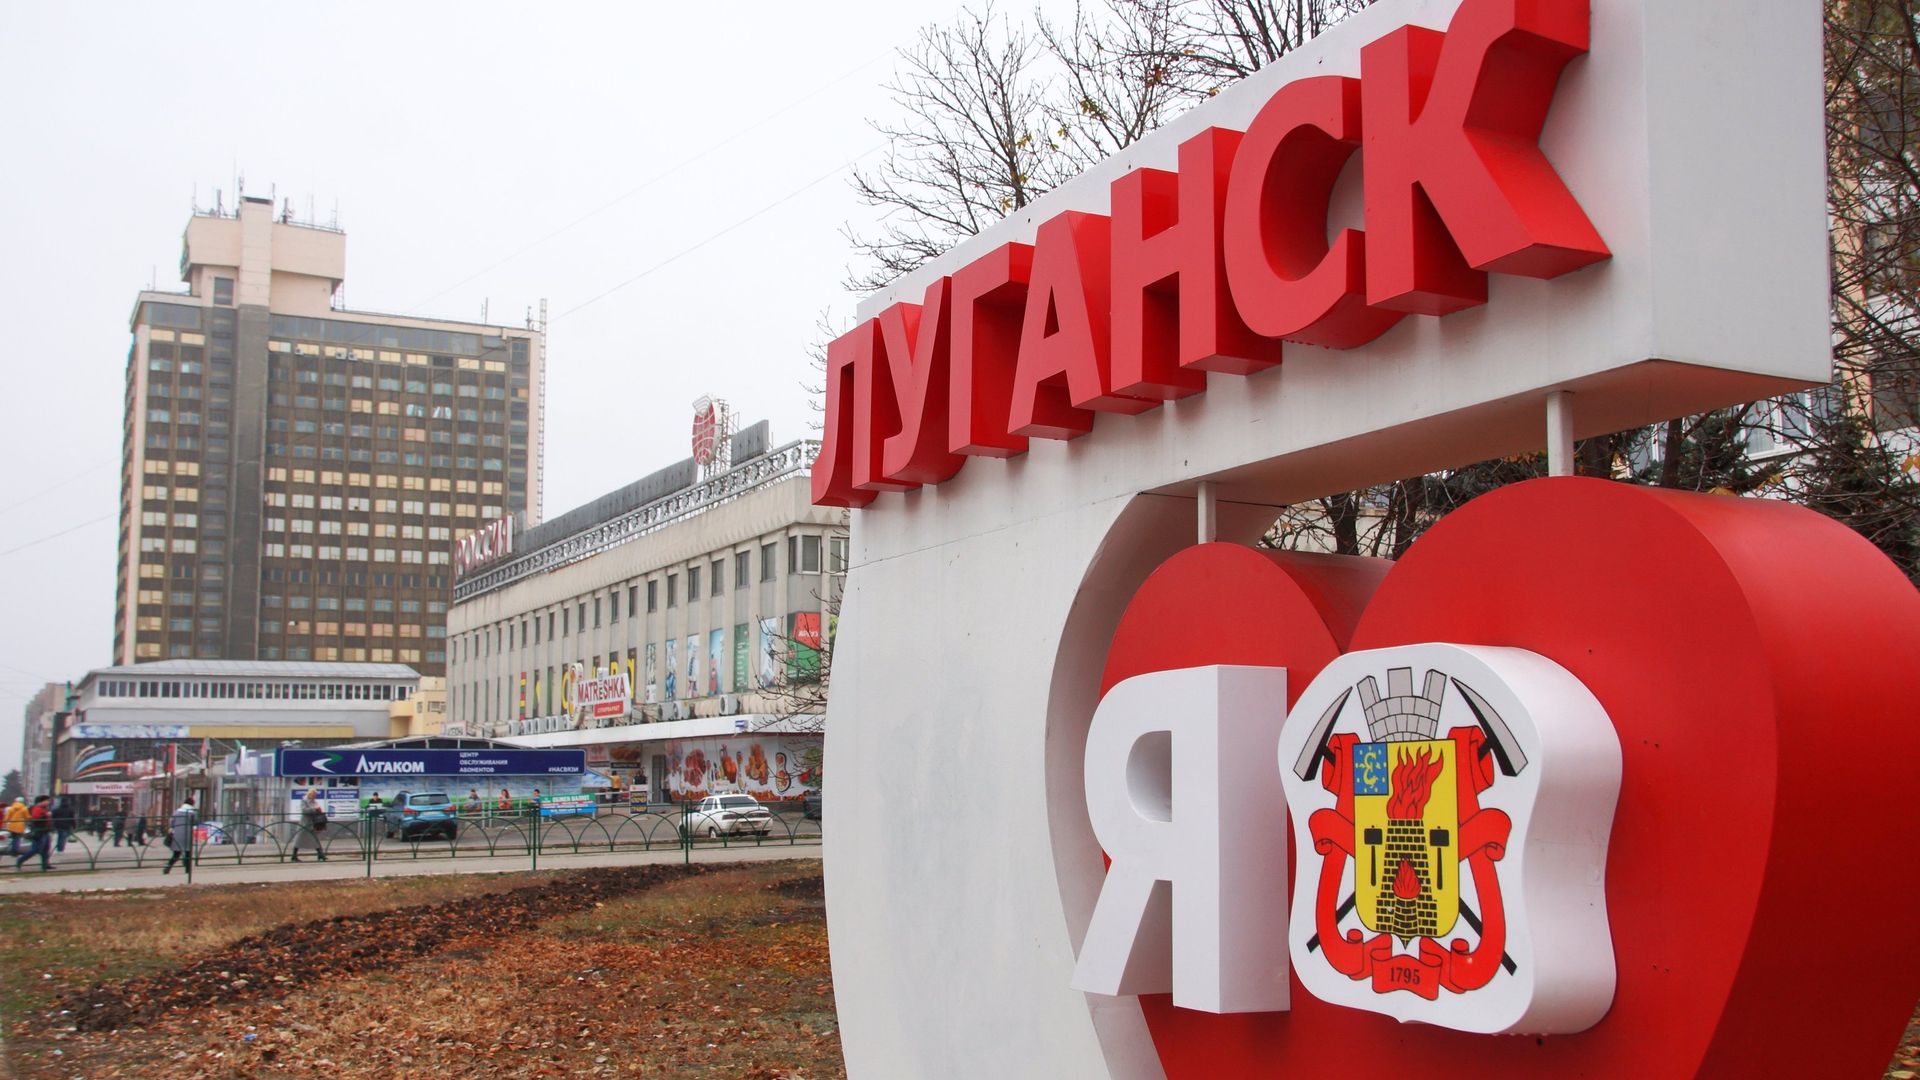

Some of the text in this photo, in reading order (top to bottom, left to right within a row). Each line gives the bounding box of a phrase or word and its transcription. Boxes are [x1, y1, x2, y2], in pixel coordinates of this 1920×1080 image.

[811, 0, 1612, 507] ЛУГАНСК
[1070, 664, 1222, 1014] Я
[1390, 966, 1421, 985] 1795
